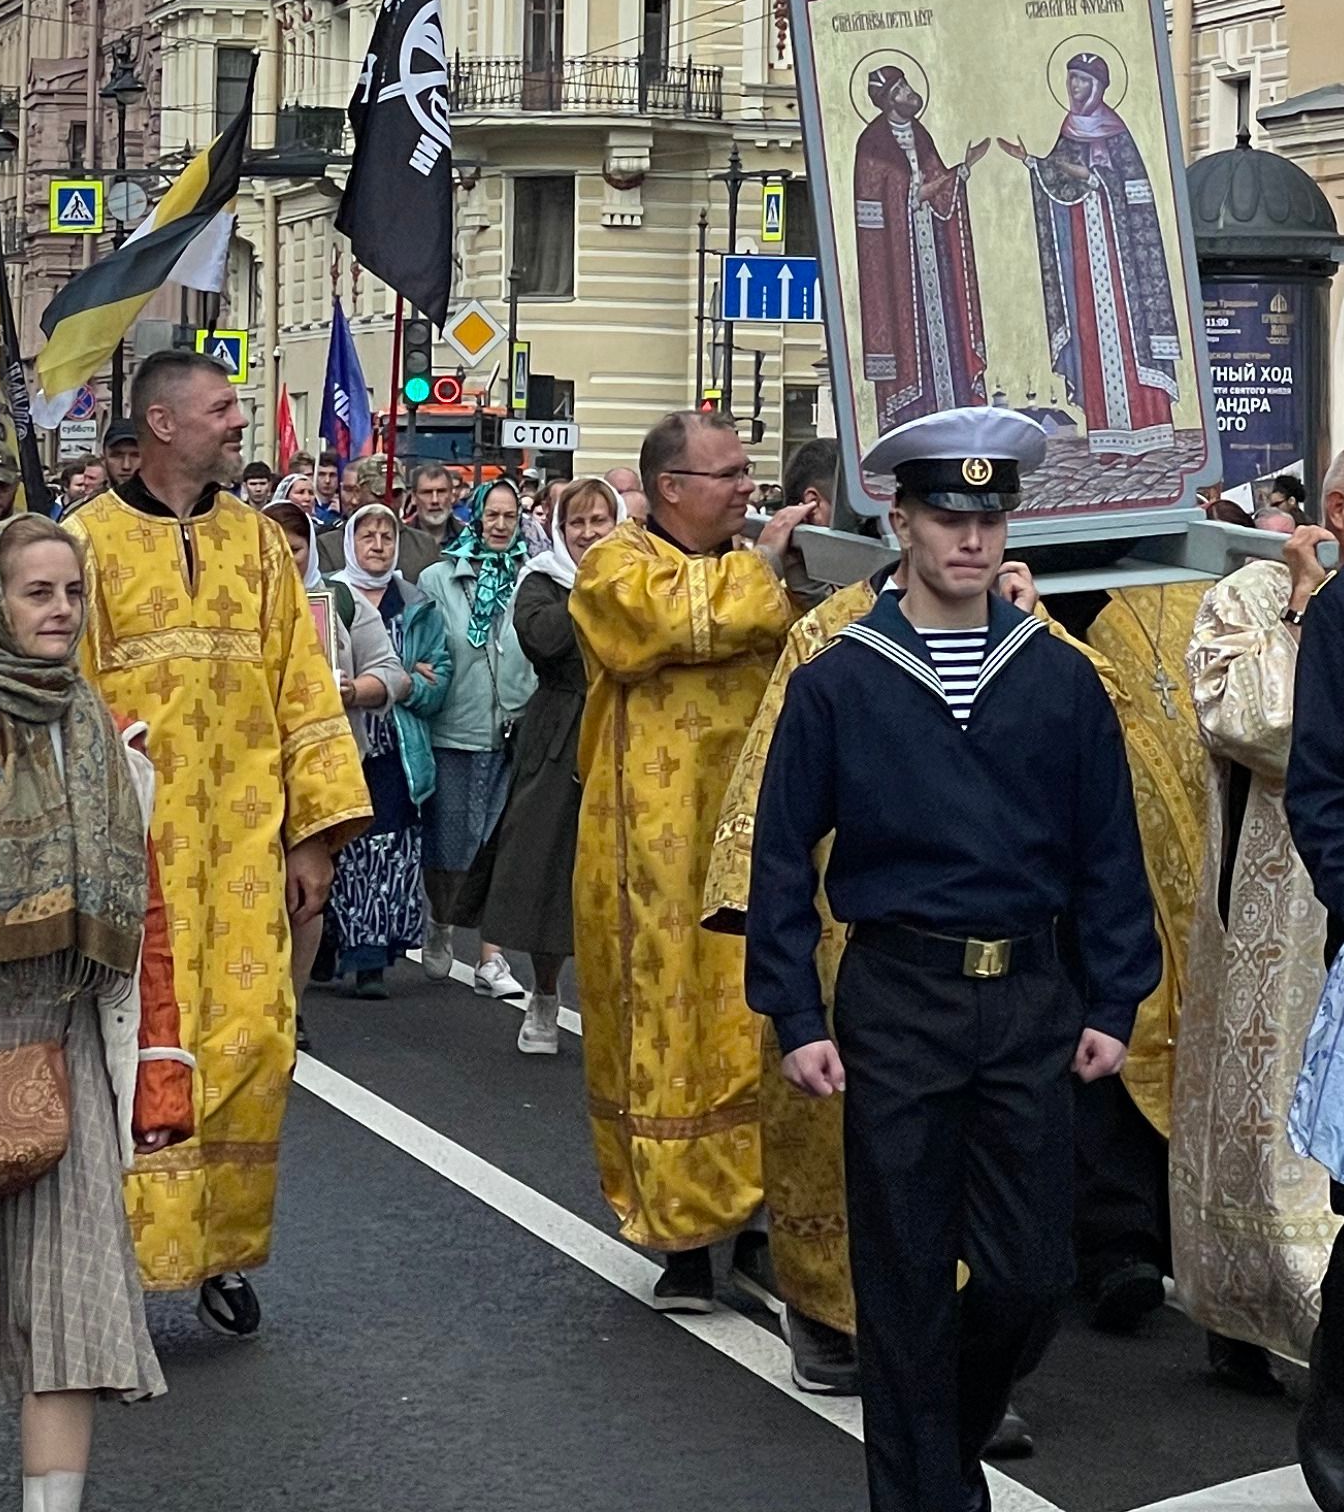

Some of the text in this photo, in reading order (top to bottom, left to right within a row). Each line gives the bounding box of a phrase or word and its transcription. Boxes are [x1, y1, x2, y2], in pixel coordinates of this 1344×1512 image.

[1260, 366, 1293, 384] ХОД
[1229, 387, 1266, 395] святого
[1216, 398, 1272, 415] АНДРА
[513, 425, 569, 445] СТОП
